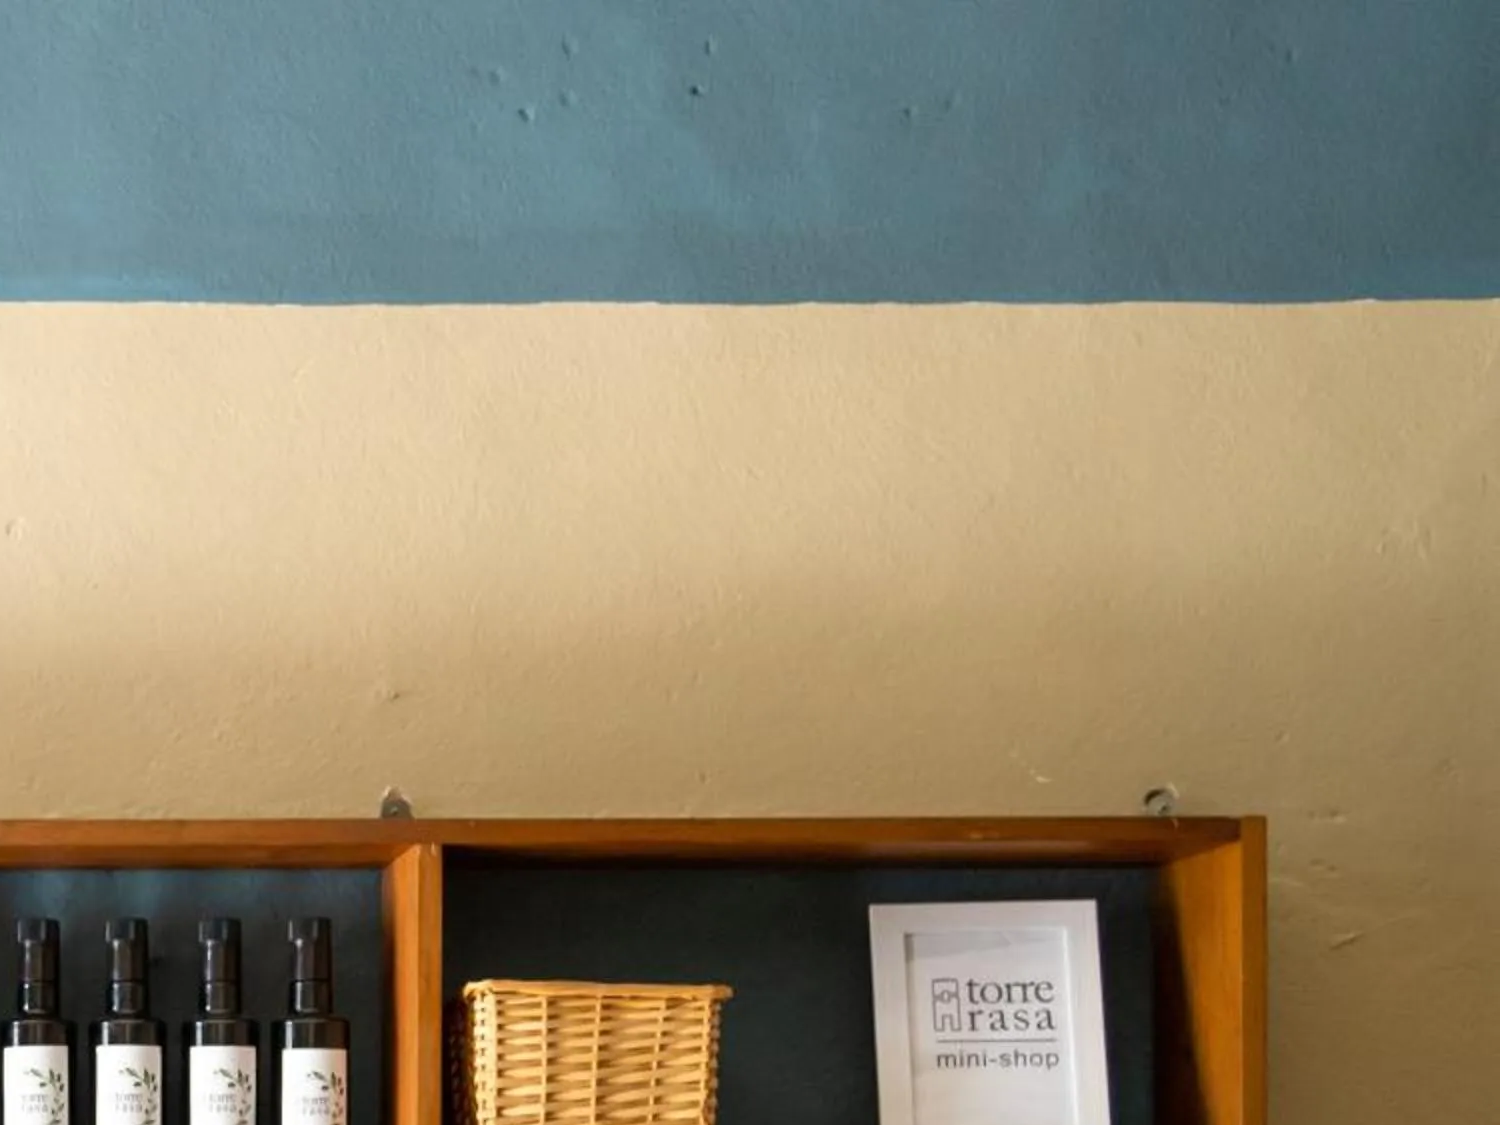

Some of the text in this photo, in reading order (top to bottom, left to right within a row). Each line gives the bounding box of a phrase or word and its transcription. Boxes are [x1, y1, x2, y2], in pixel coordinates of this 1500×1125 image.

[965, 977, 1055, 1005] torre
[967, 1008, 1056, 1032] rasa
[936, 1048, 1060, 1070] mini-shop
